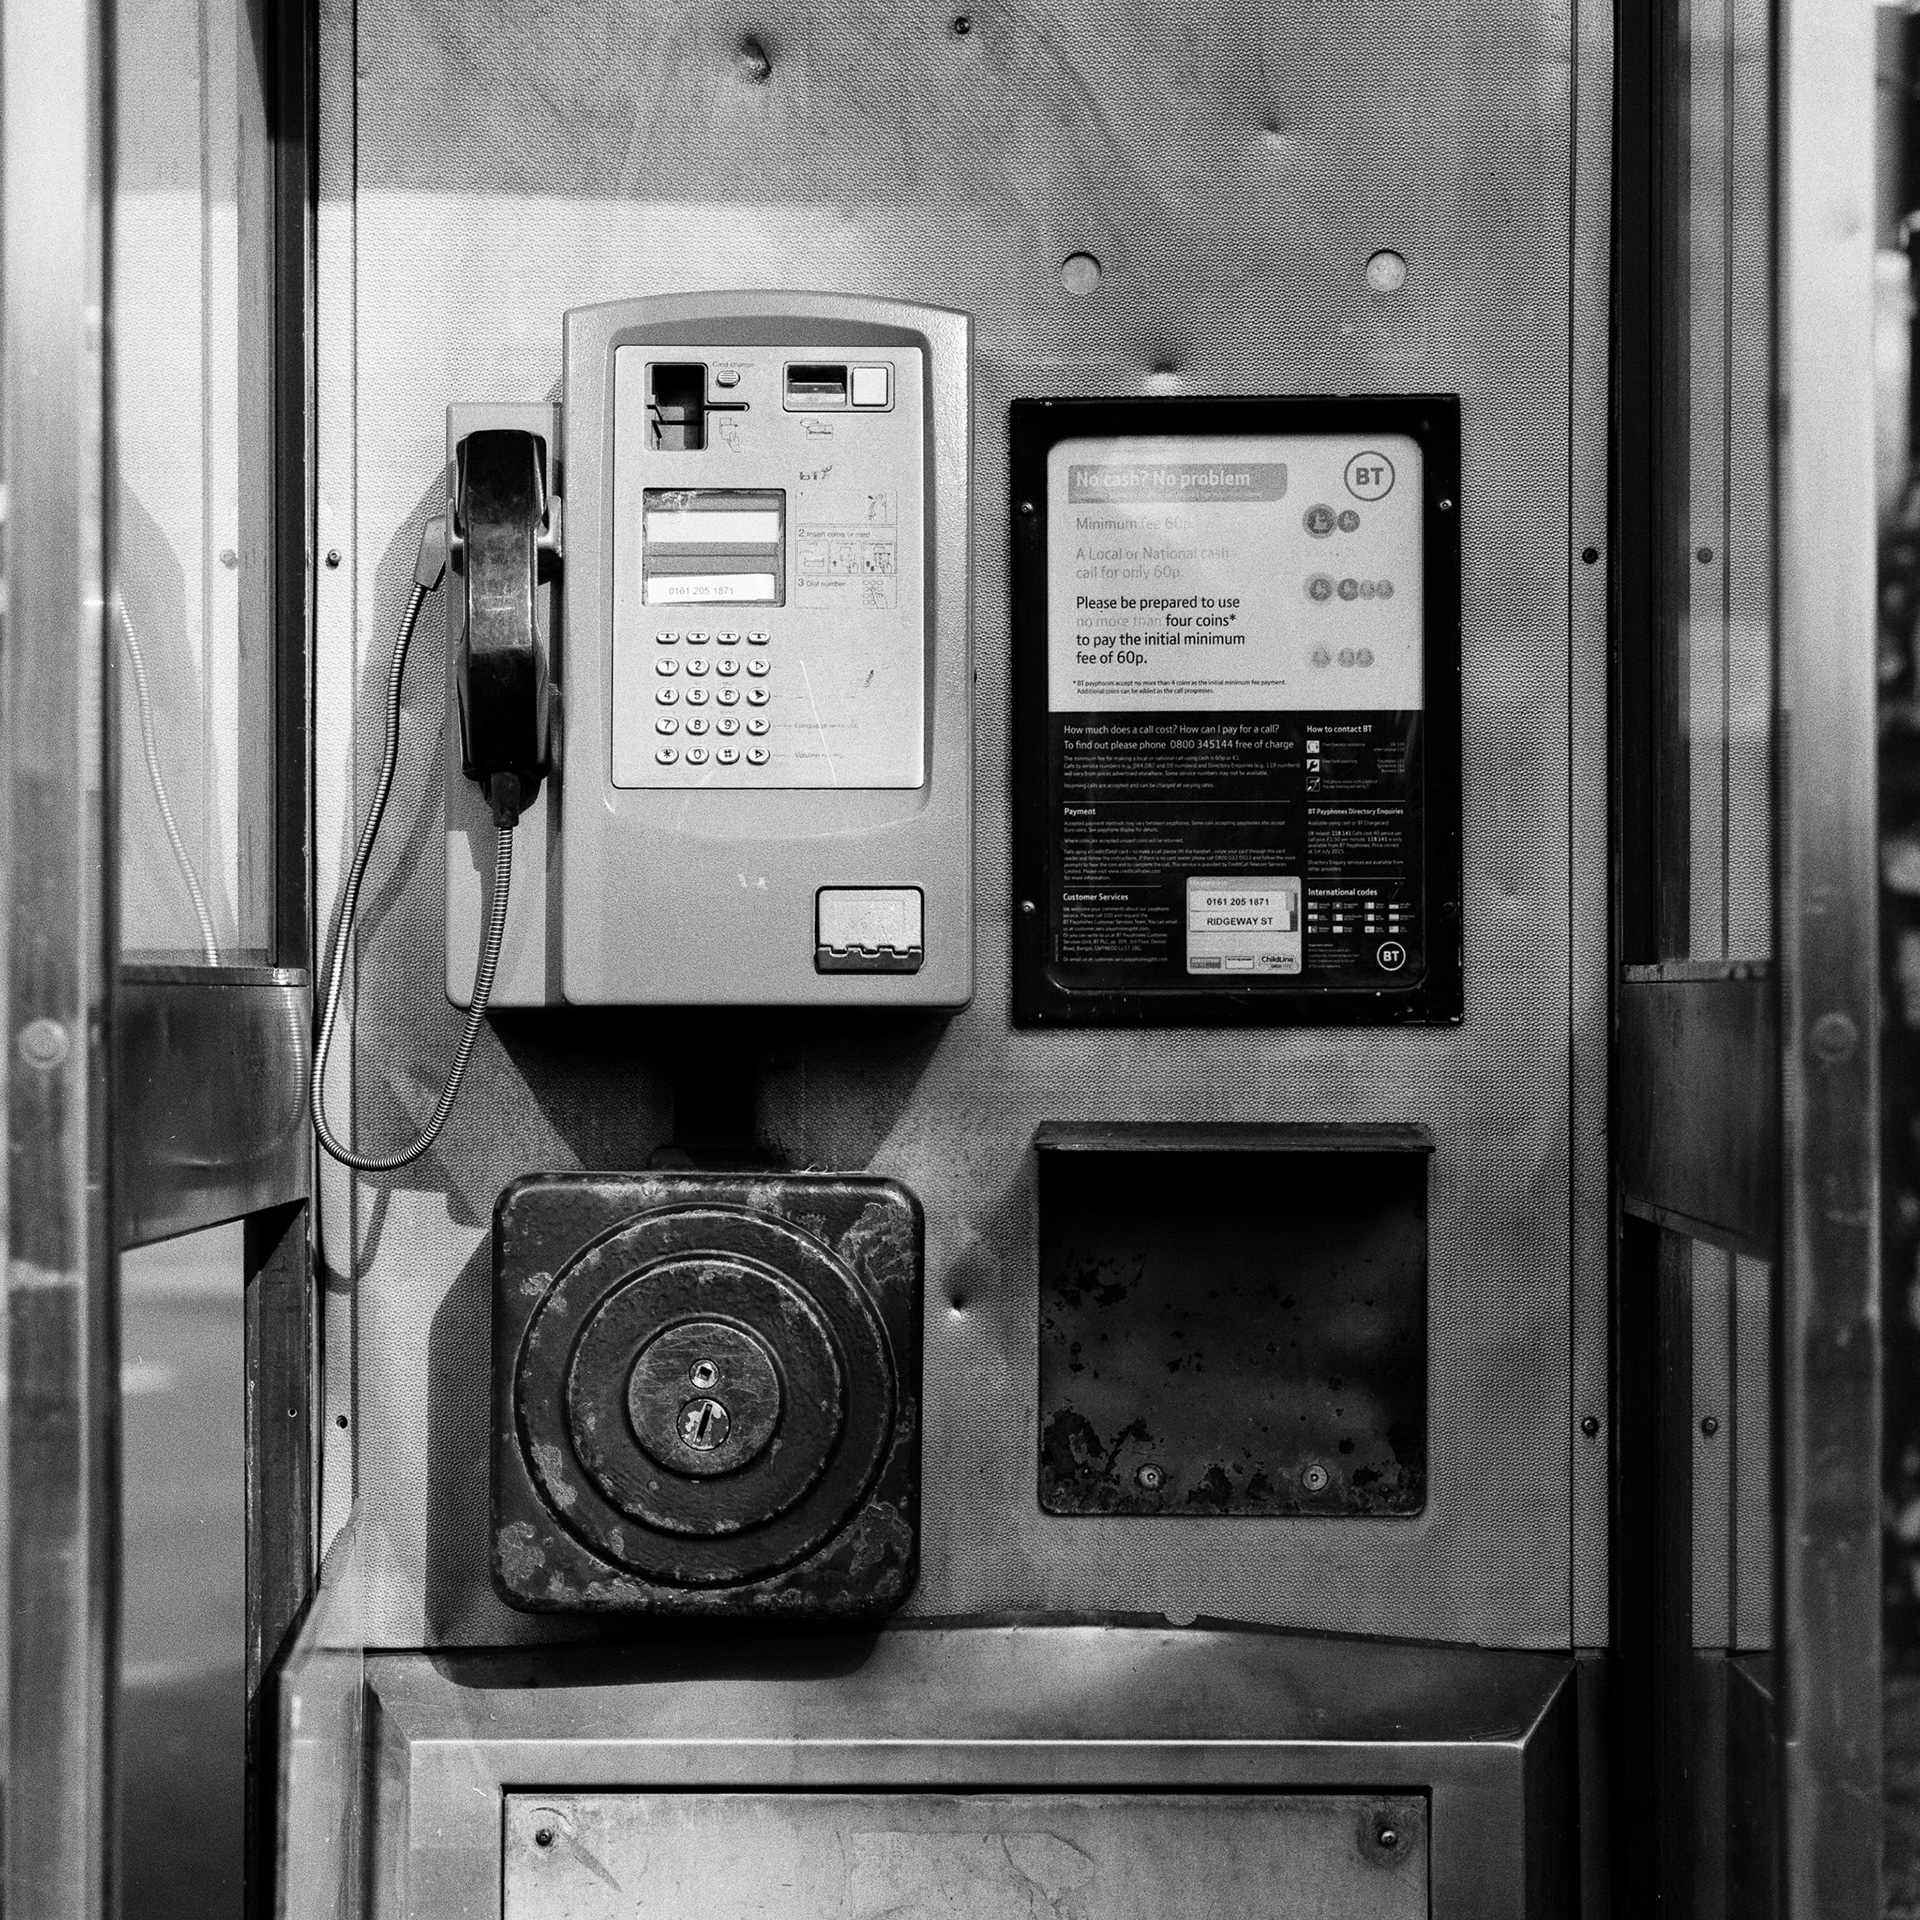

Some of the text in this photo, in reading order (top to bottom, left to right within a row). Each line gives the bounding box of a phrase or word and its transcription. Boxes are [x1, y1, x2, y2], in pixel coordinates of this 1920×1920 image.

[1077, 469, 1250, 489] No cash? No problem
[1355, 467, 1385, 485] BT
[1076, 517, 1137, 530] Minimum
[798, 528, 805, 538] 2
[1076, 548, 1086, 560] A
[1089, 547, 1122, 560] Local
[1125, 550, 1140, 560] or
[1142, 546, 1197, 560] National
[1076, 566, 1098, 579] call
[1101, 565, 1120, 579] for
[1122, 564, 1149, 580] only
[797, 578, 805, 588] 3
[668, 587, 735, 595] 0161 205 1871
[1076, 595, 1240, 611] Please be prepared to use
[1076, 618, 1093, 627] no
[1096, 618, 1129, 627] more
[1131, 615, 1162, 627] than
[1165, 613, 1192, 627] four
[1076, 632, 1245, 648] to pay the initial minimum
[1076, 650, 1148, 666] fee of 60p.
[665, 660, 731, 671] 1 2 3
[664, 690, 731, 700] 4 5 6
[664, 719, 731, 730] 7 8 9
[1064, 725, 1083, 734] How
[1085, 725, 1109, 734] much
[1110, 725, 1130, 734] does
[1139, 725, 1154, 734] call
[1155, 724, 1177, 734] cost?
[1179, 725, 1199, 733] How
[1217, 725, 1221, 733] I
[1222, 727, 1238, 735] pay
[1239, 724, 1251, 733] for
[1260, 724, 1280, 733] call?
[1063, 740, 1294, 751] To find out please phone 0800 345144 free of charge
[694, 749, 701, 760] 0
[1064, 808, 1096, 816] Payment
[1063, 893, 1097, 901] Customer
[1230, 898, 1246, 906] 205
[1206, 917, 1273, 925] RIDGEWAY ST
[1261, 955, 1294, 963] ChildLine
[1382, 951, 1401, 961] BT
